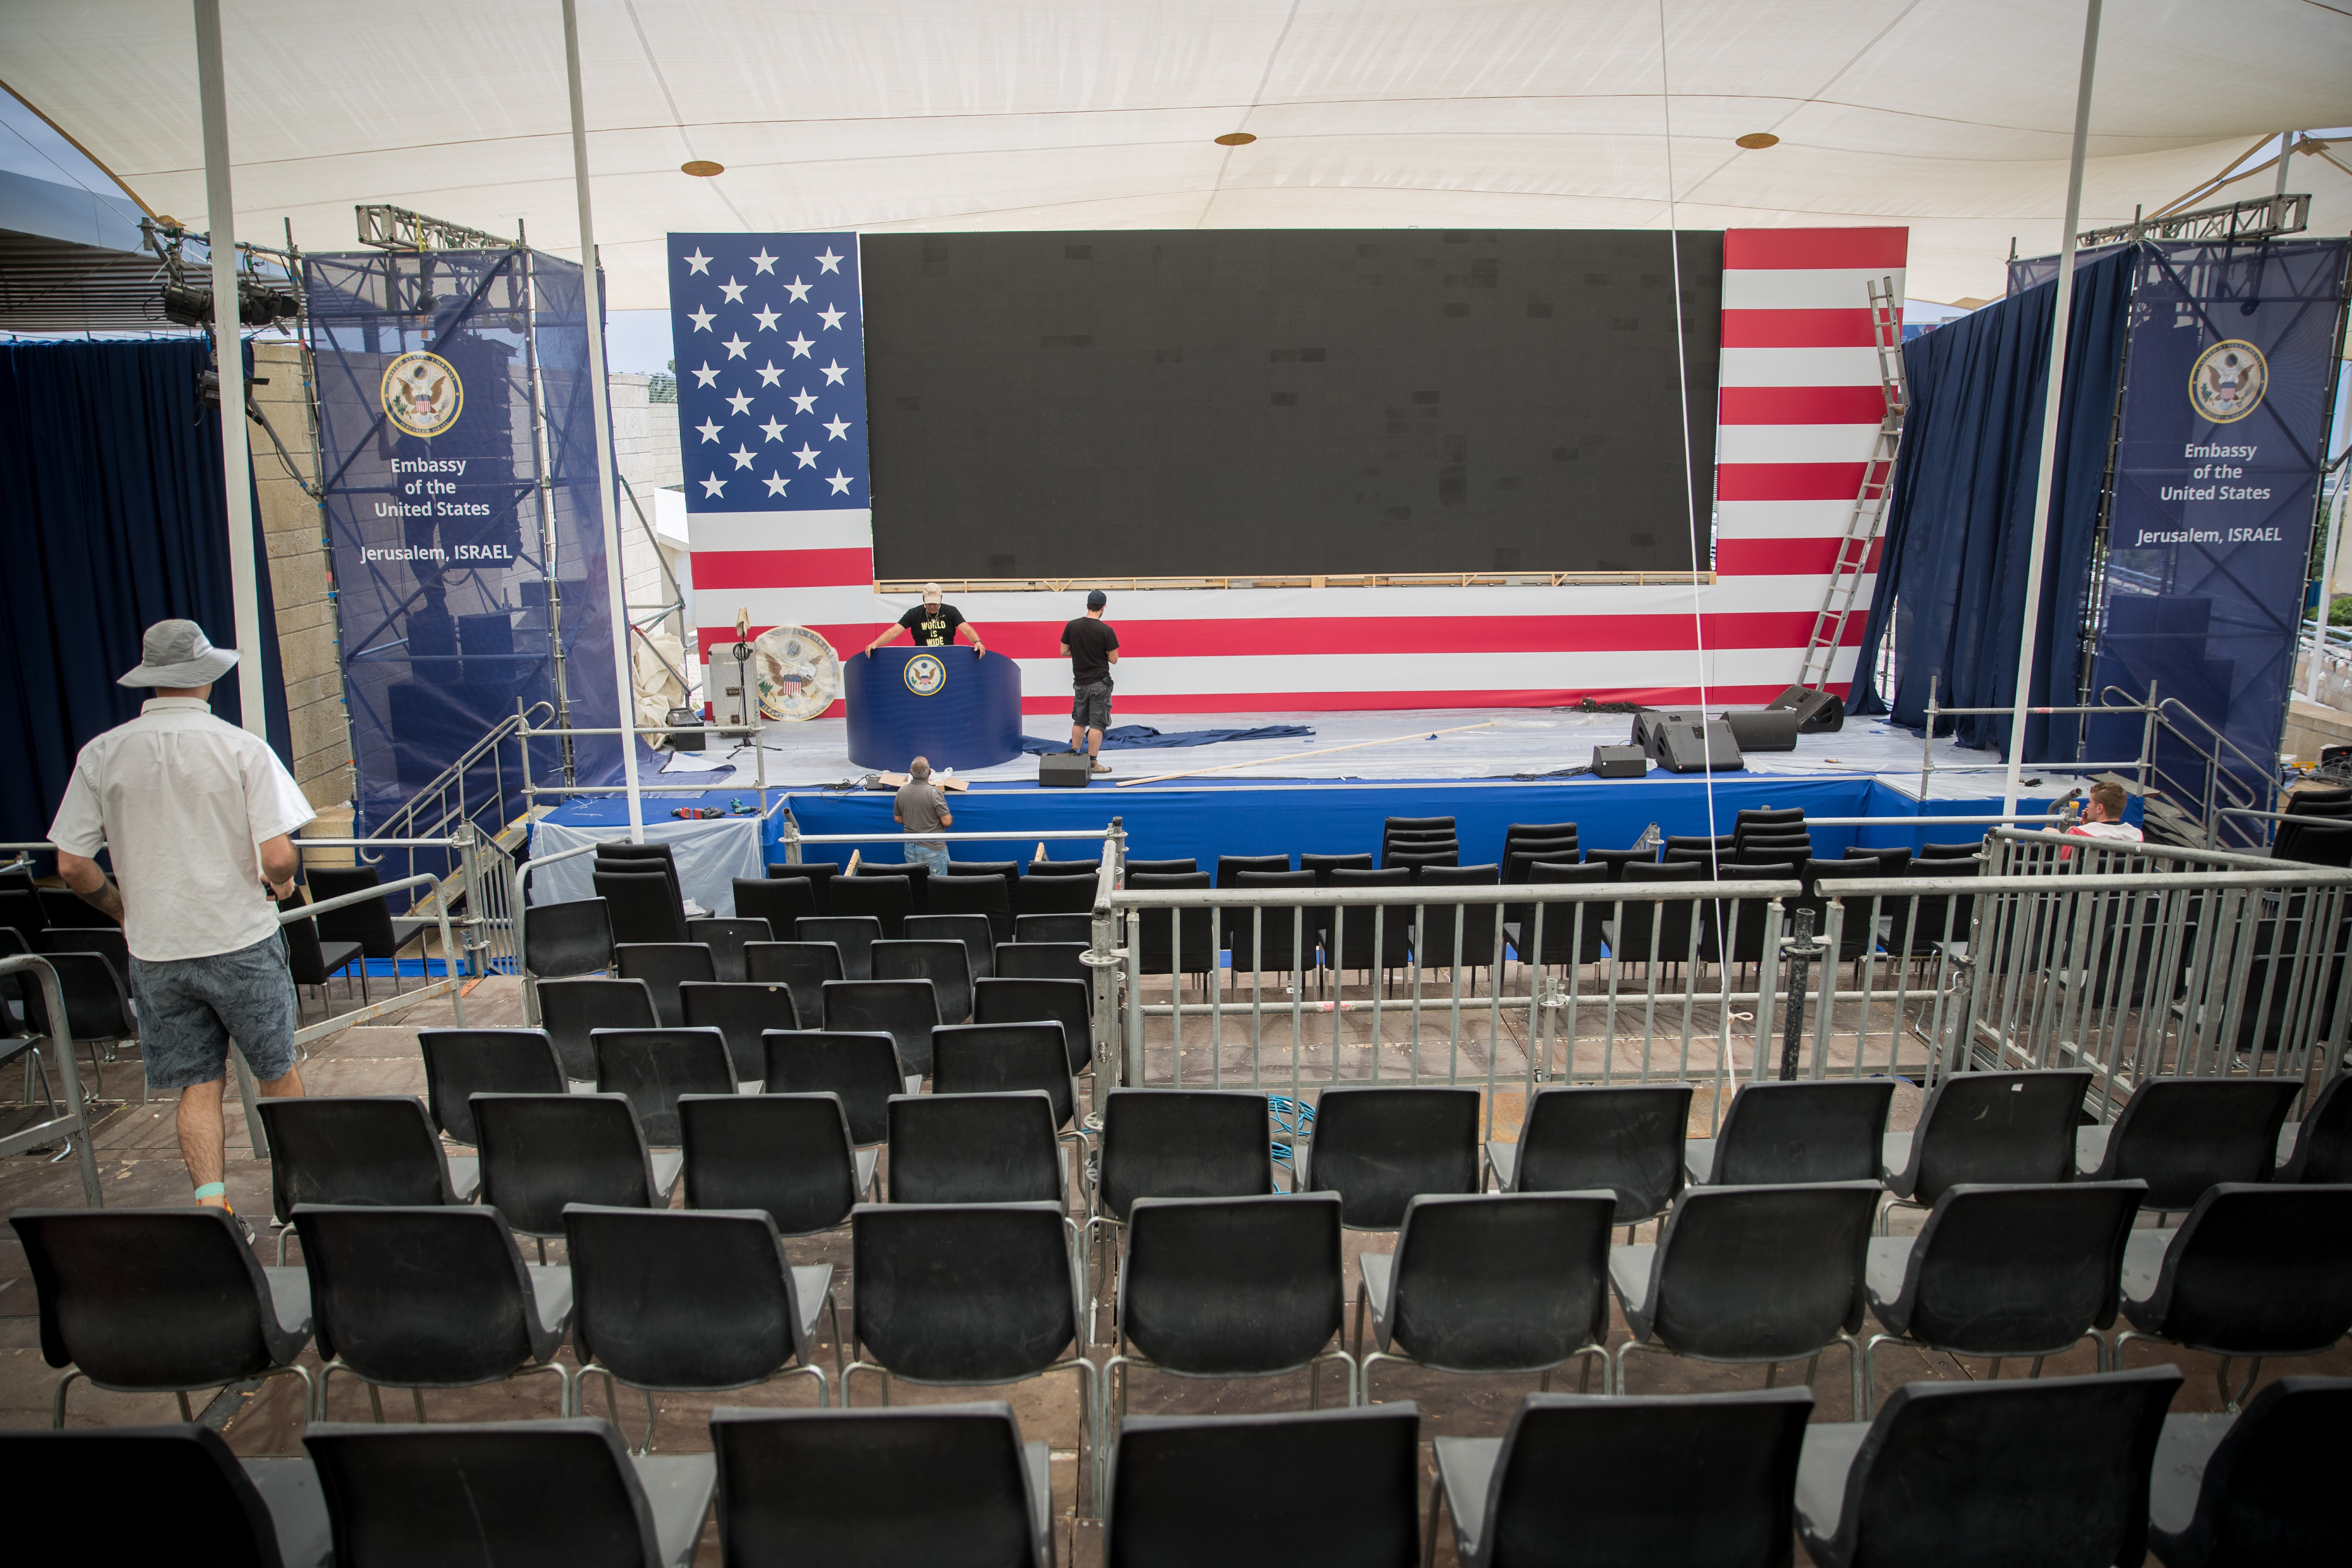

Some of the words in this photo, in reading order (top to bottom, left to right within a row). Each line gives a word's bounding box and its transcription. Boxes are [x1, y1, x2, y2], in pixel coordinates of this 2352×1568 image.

[387, 361, 403, 382] UNITED
[432, 358, 456, 381] EMBASSY
[432, 421, 450, 432] ISRAEL
[2185, 443, 2257, 461] Embassy
[391, 457, 466, 476] Embassy
[2193, 465, 2212, 479] of
[2214, 464, 2242, 478] the
[405, 480, 423, 494] of
[426, 479, 456, 494] the
[2160, 486, 2215, 500] United
[2219, 486, 2271, 500] States
[375, 502, 432, 517] United
[437, 502, 490, 516] States
[2135, 529, 2223, 546] Jerusalem,
[2228, 527, 2282, 542] ISRAEL
[360, 545, 450, 564] Jerusalem,
[455, 545, 513, 559] ISRAEL
[921, 621, 946, 630] WORLD
[926, 636, 944, 646] WIDE
